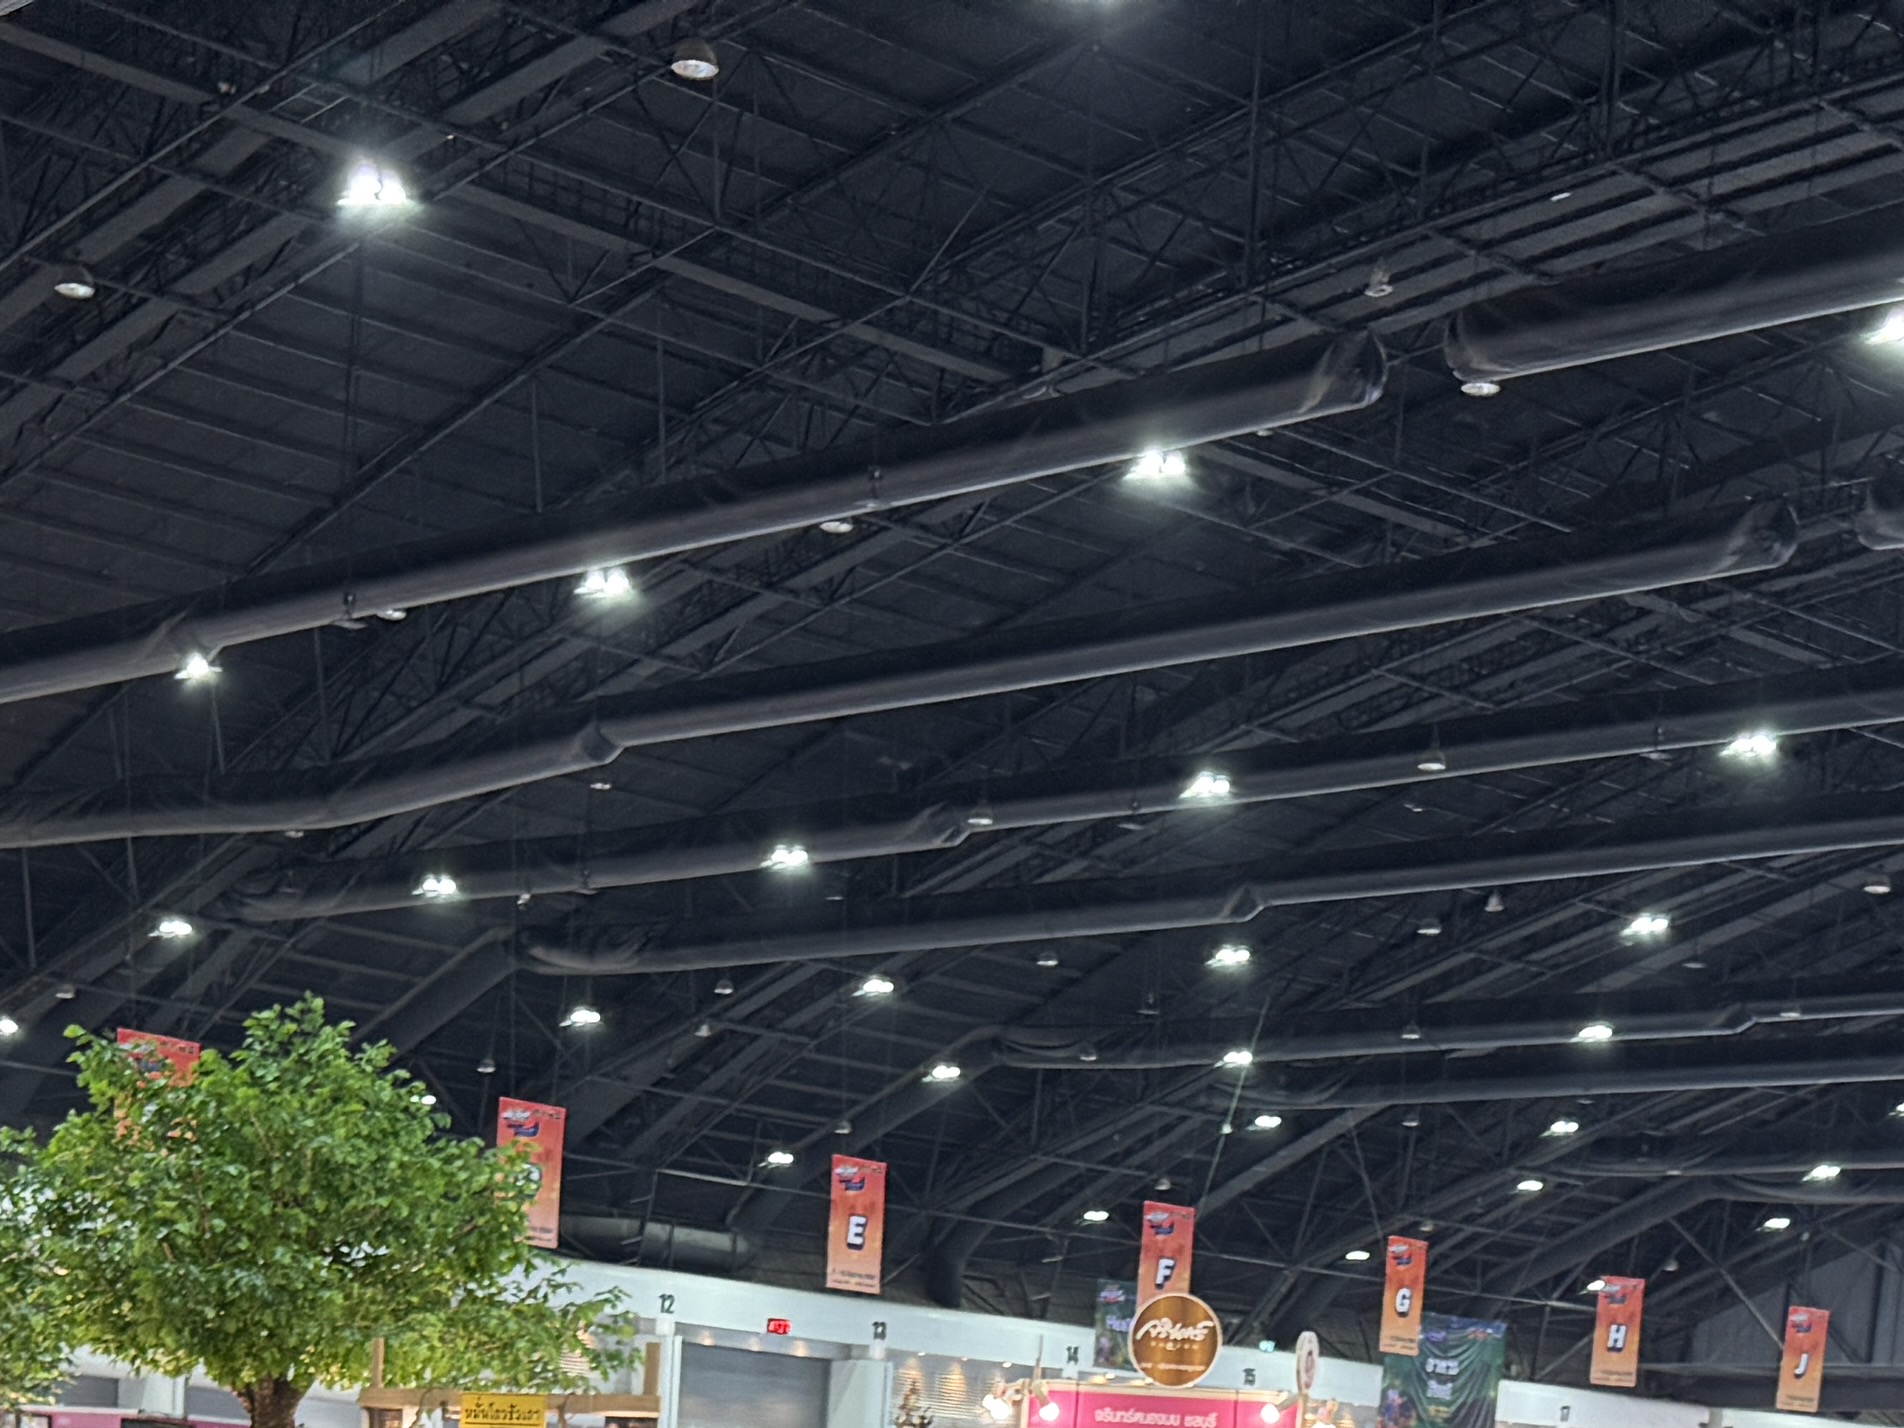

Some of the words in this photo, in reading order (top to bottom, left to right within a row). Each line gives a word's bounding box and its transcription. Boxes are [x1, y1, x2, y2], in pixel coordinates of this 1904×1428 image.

[847, 1214, 866, 1250] E
[1156, 1258, 1175, 1289] F
[659, 1294, 674, 1314] 12
[1395, 1285, 1411, 1317] G
[1607, 1322, 1626, 1352] H
